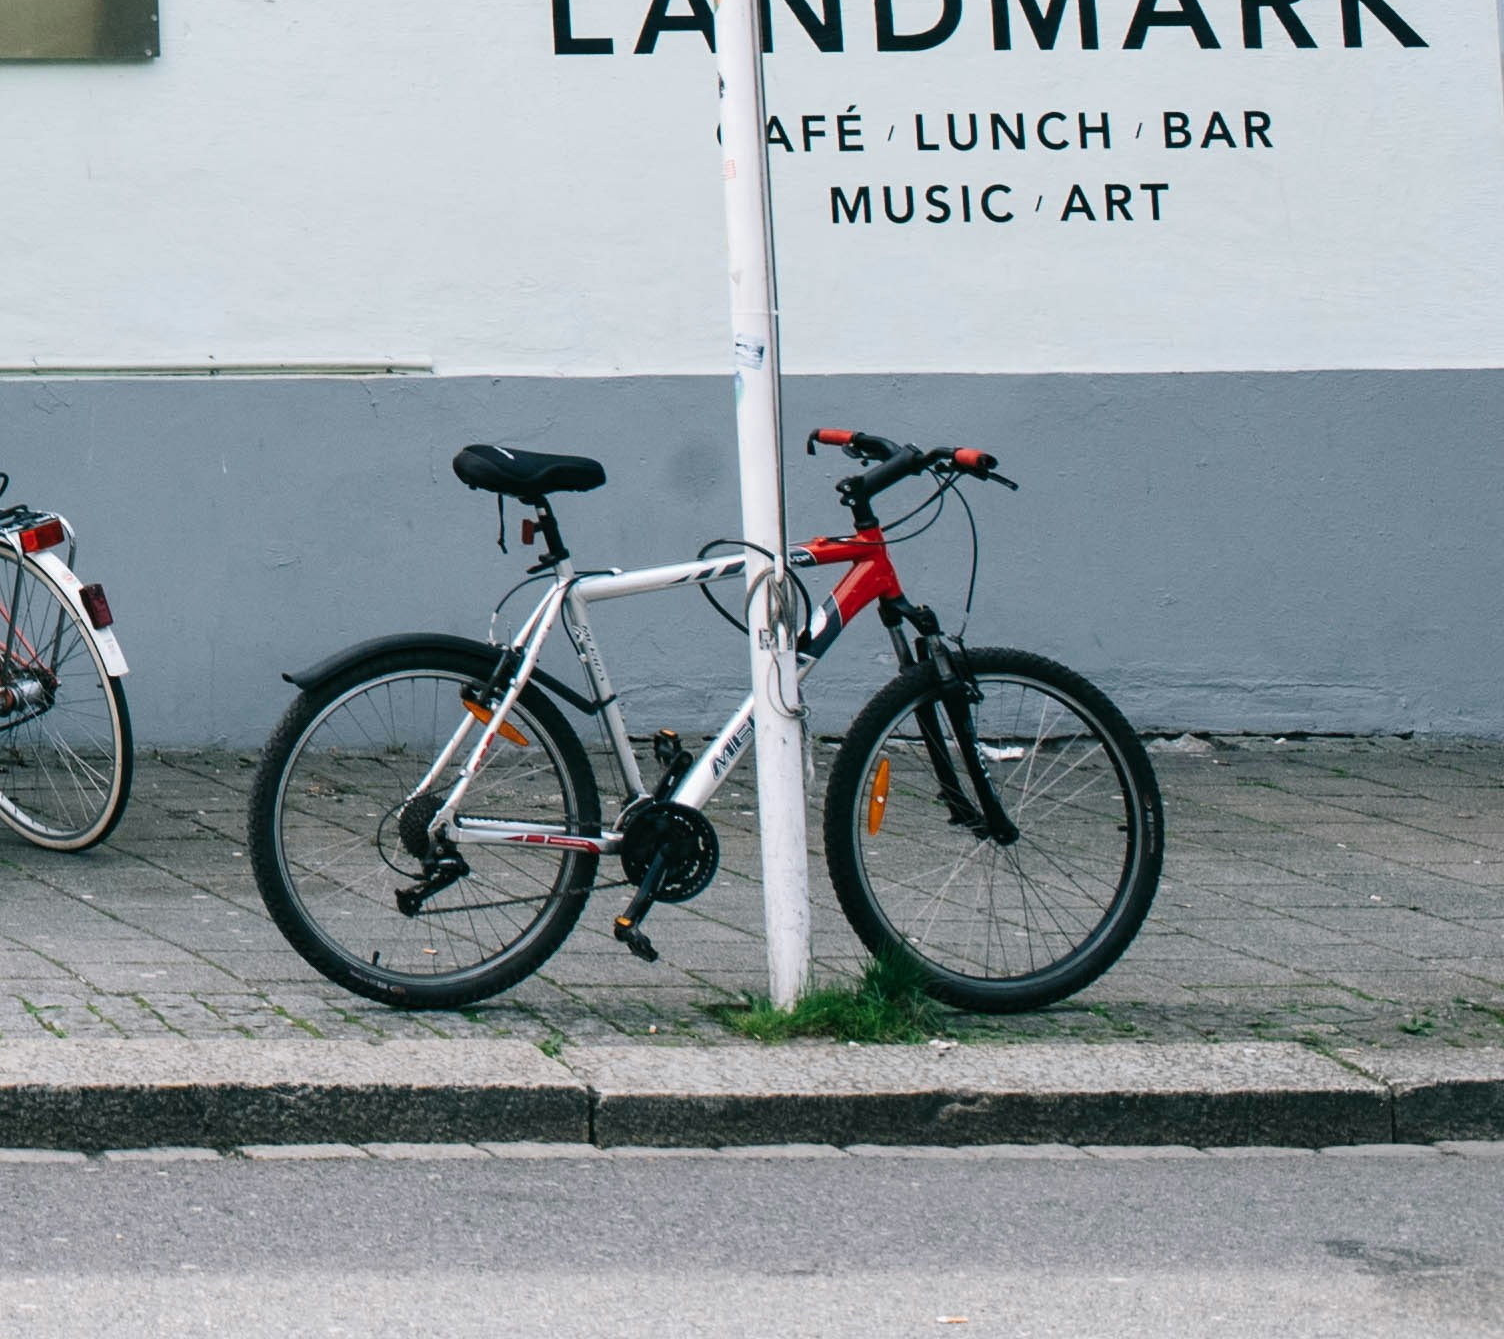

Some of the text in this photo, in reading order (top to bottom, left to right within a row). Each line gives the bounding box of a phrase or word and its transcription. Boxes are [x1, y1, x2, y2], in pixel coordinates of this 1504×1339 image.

[717, 105, 865, 152] AFÉ
[916, 111, 1113, 153] LUNCH
[1163, 110, 1275, 150] BAR
[830, 185, 1015, 225] MUSIC
[1061, 183, 1171, 223] ART
